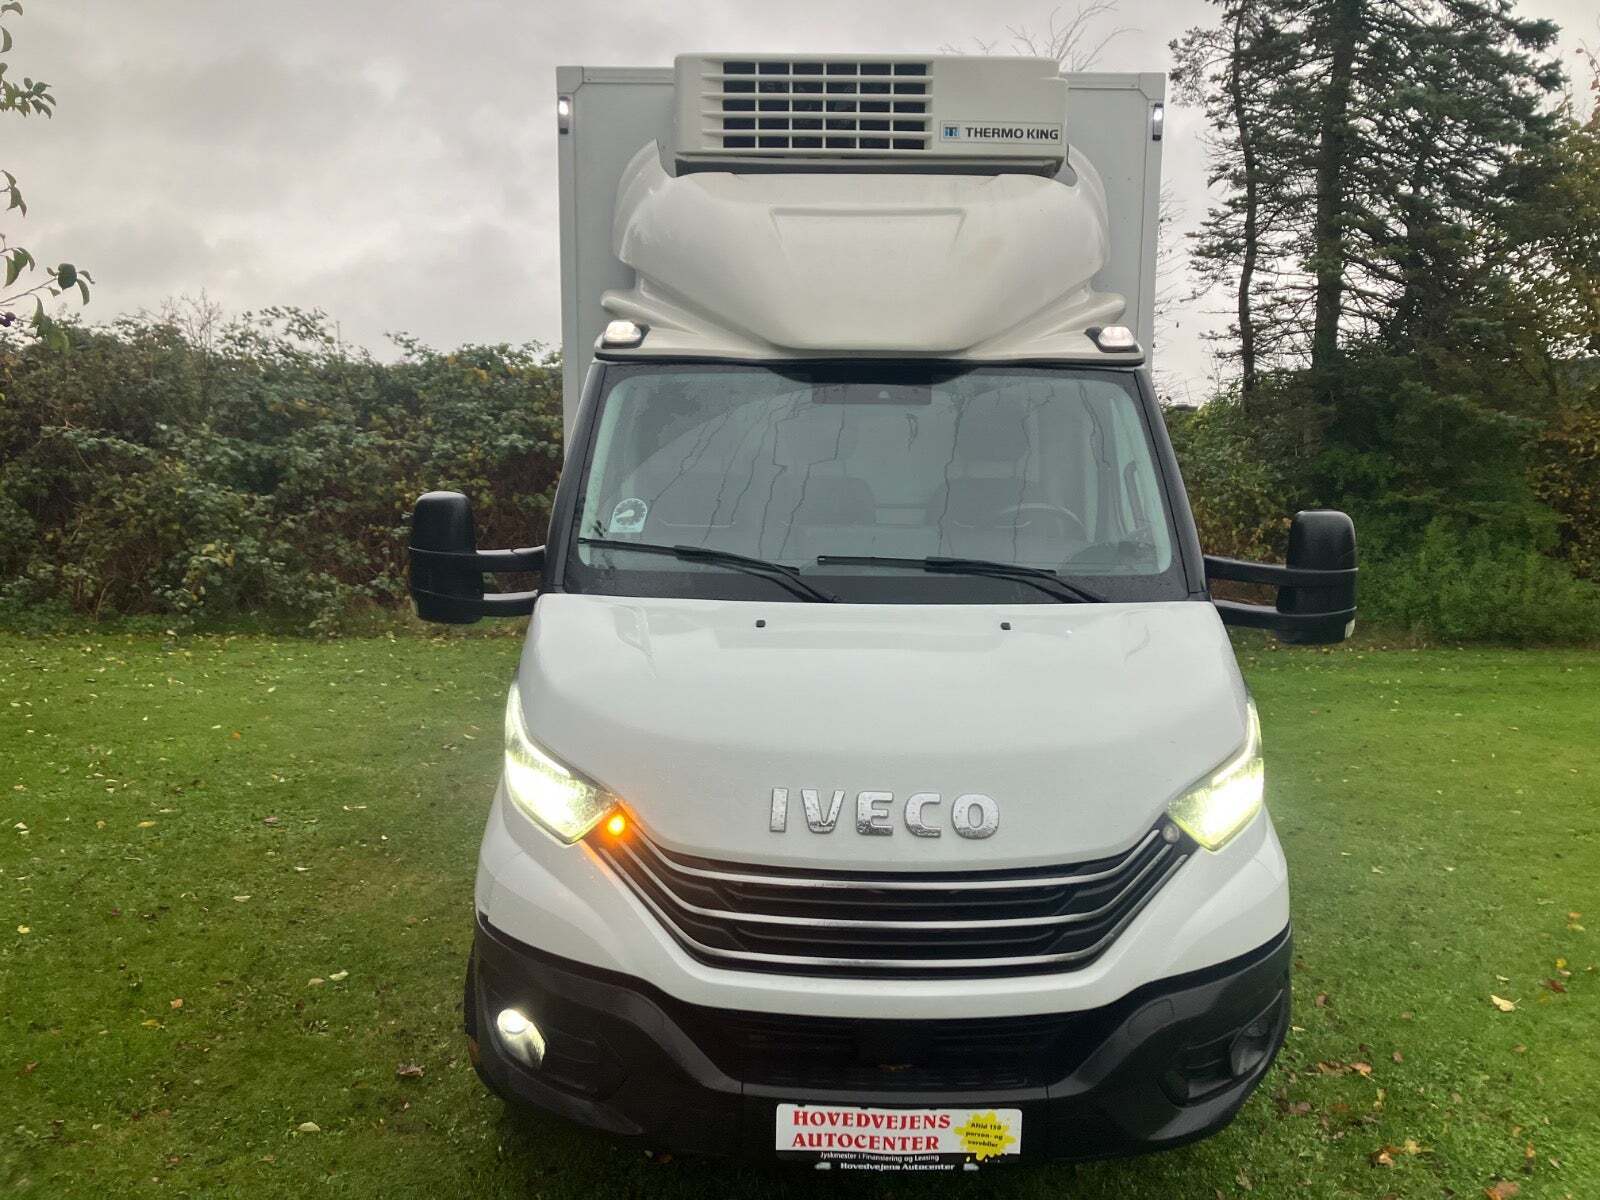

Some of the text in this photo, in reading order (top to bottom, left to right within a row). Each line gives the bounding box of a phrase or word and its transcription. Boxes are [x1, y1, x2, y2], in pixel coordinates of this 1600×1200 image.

[966, 127, 1024, 139] THERMO
[1026, 128, 1059, 140] KING
[769, 787, 1000, 840] IVECO
[792, 1110, 951, 1130] HOVEDVEJENS
[791, 1132, 940, 1151] AUTOCENTER
[862, 1153, 903, 1164] Finansiering
[904, 1155, 913, 1164] og
[914, 1154, 940, 1164] Leasing
[840, 1162, 956, 1172] Hovedvejens Autocenter
